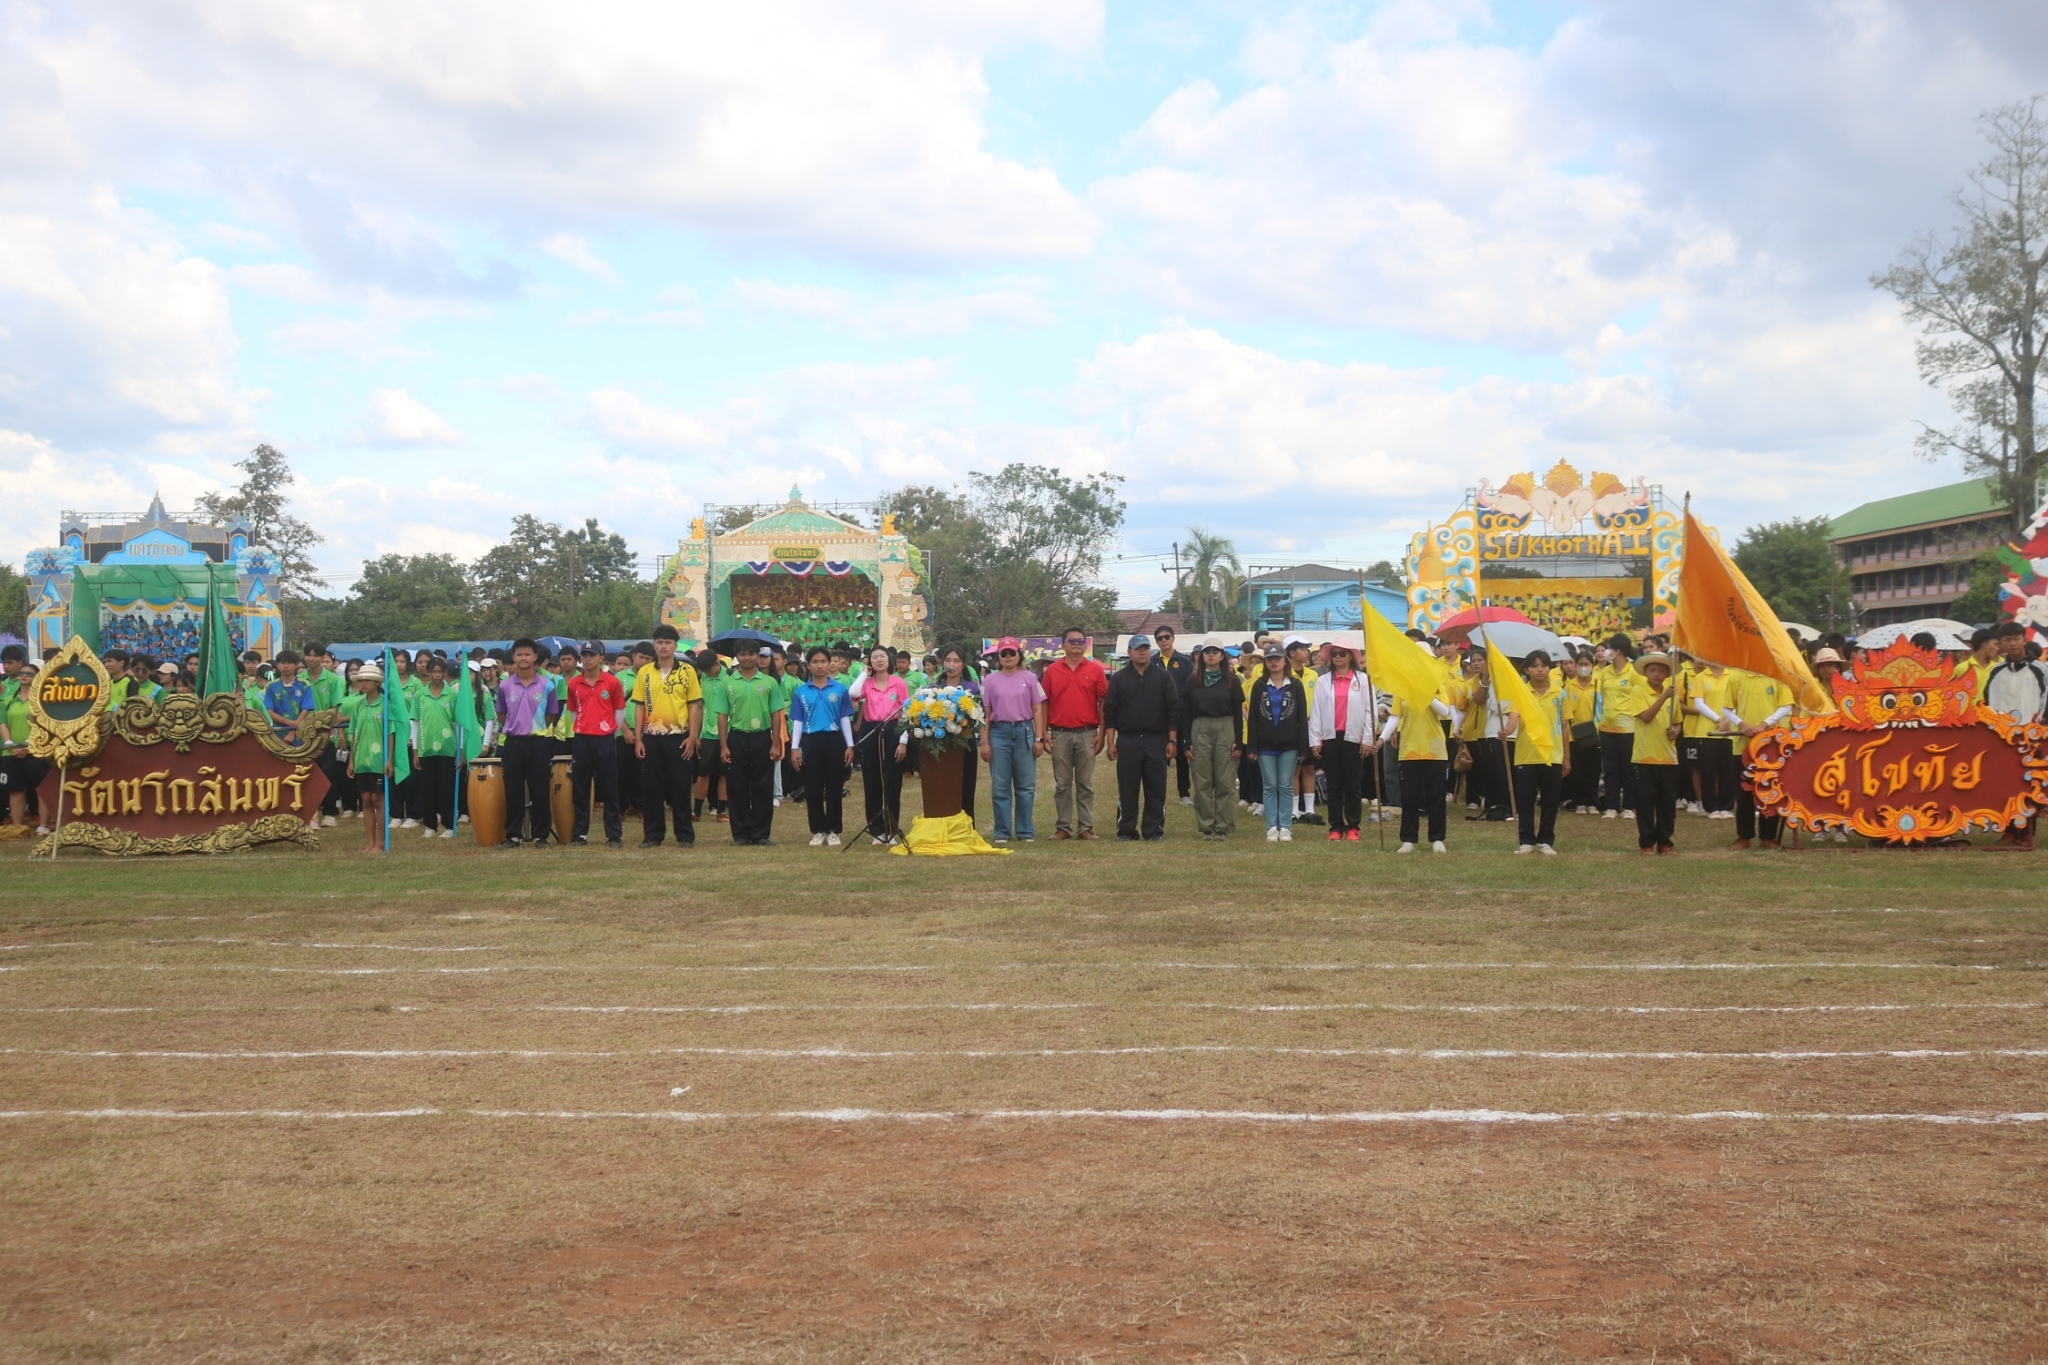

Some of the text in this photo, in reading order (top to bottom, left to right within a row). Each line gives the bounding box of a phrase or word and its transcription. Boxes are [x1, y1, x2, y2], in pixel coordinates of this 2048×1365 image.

[1483, 529, 1649, 560] SUKHOTHAI
[43, 676, 99, 702] สีเขียว
[1687, 748, 1698, 759] 12
[1813, 730, 1988, 813] สุโขทัย
[63, 763, 313, 816] รัตนโกสินทร์
